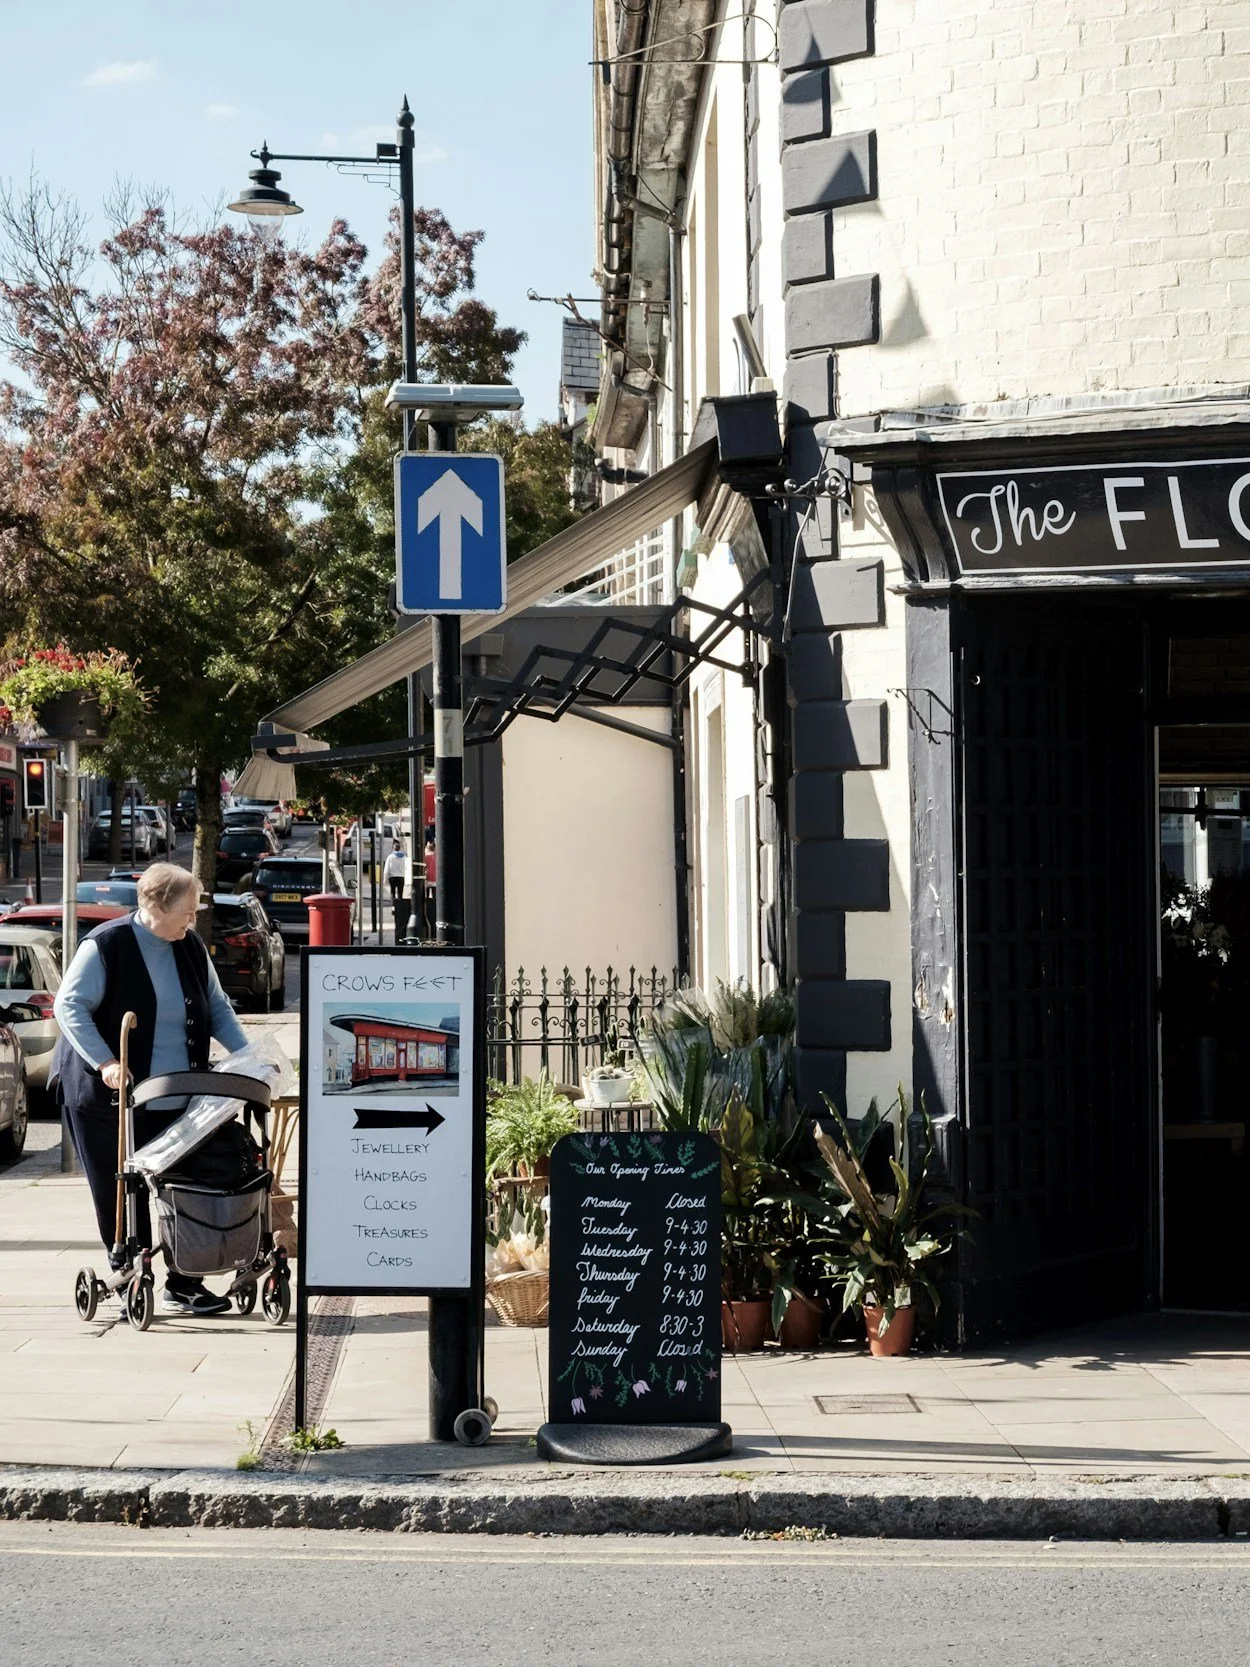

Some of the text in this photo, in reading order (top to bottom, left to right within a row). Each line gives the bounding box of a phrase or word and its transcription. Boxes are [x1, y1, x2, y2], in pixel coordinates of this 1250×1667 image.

[956, 478, 1076, 555] The
[322, 973, 463, 992] CROWS FEET
[351, 1138, 430, 1155] JEWELLERY
[354, 1167, 428, 1183] HANDBAGS
[586, 1162, 605, 1174] Our
[610, 1162, 650, 1181] Opening
[363, 1195, 418, 1211] CLOCKS
[581, 1192, 706, 1216] Monday Closed
[353, 1224, 429, 1240] TREASURES
[581, 1216, 638, 1242] Tuesday
[366, 1252, 413, 1268] CARDS
[580, 1242, 653, 1266] Wednesday
[576, 1261, 641, 1292] Thursday
[571, 1316, 641, 1344] Saturday
[571, 1339, 704, 1367] Sunday Closed
